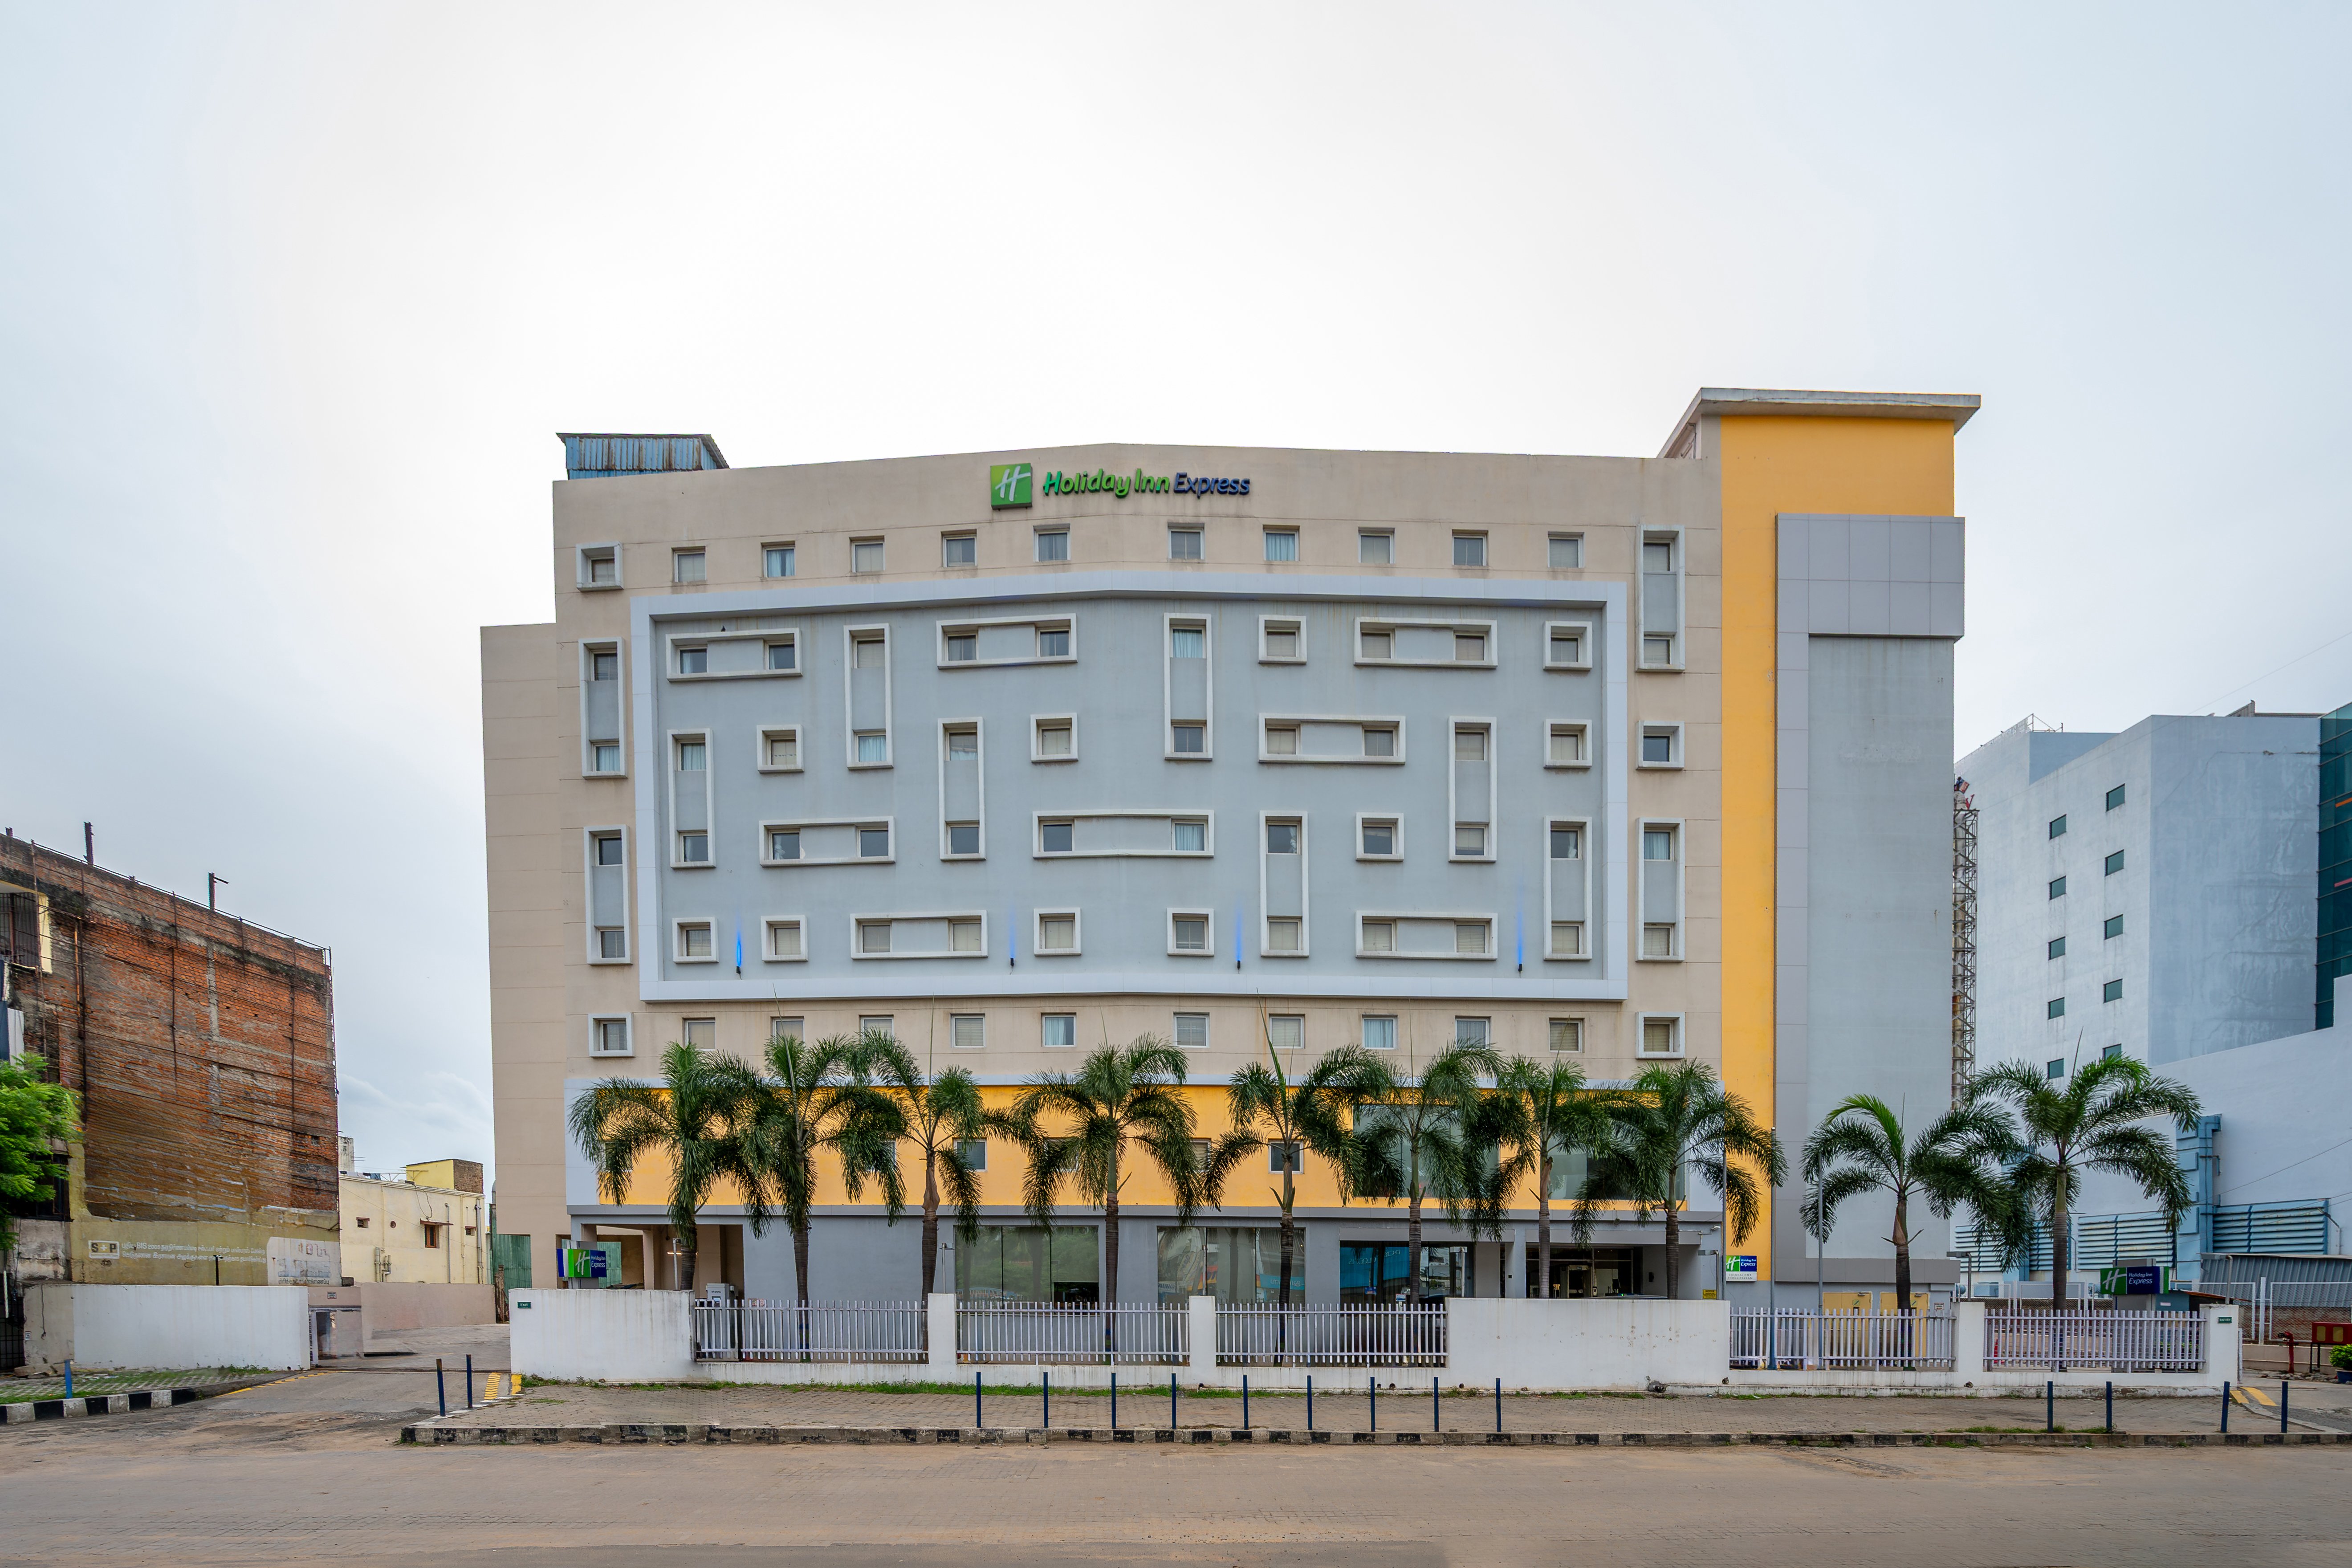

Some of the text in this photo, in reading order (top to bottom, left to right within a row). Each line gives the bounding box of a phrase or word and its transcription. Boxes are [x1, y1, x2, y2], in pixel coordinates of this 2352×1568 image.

[1043, 468, 1250, 499] Holiday Inn Express
